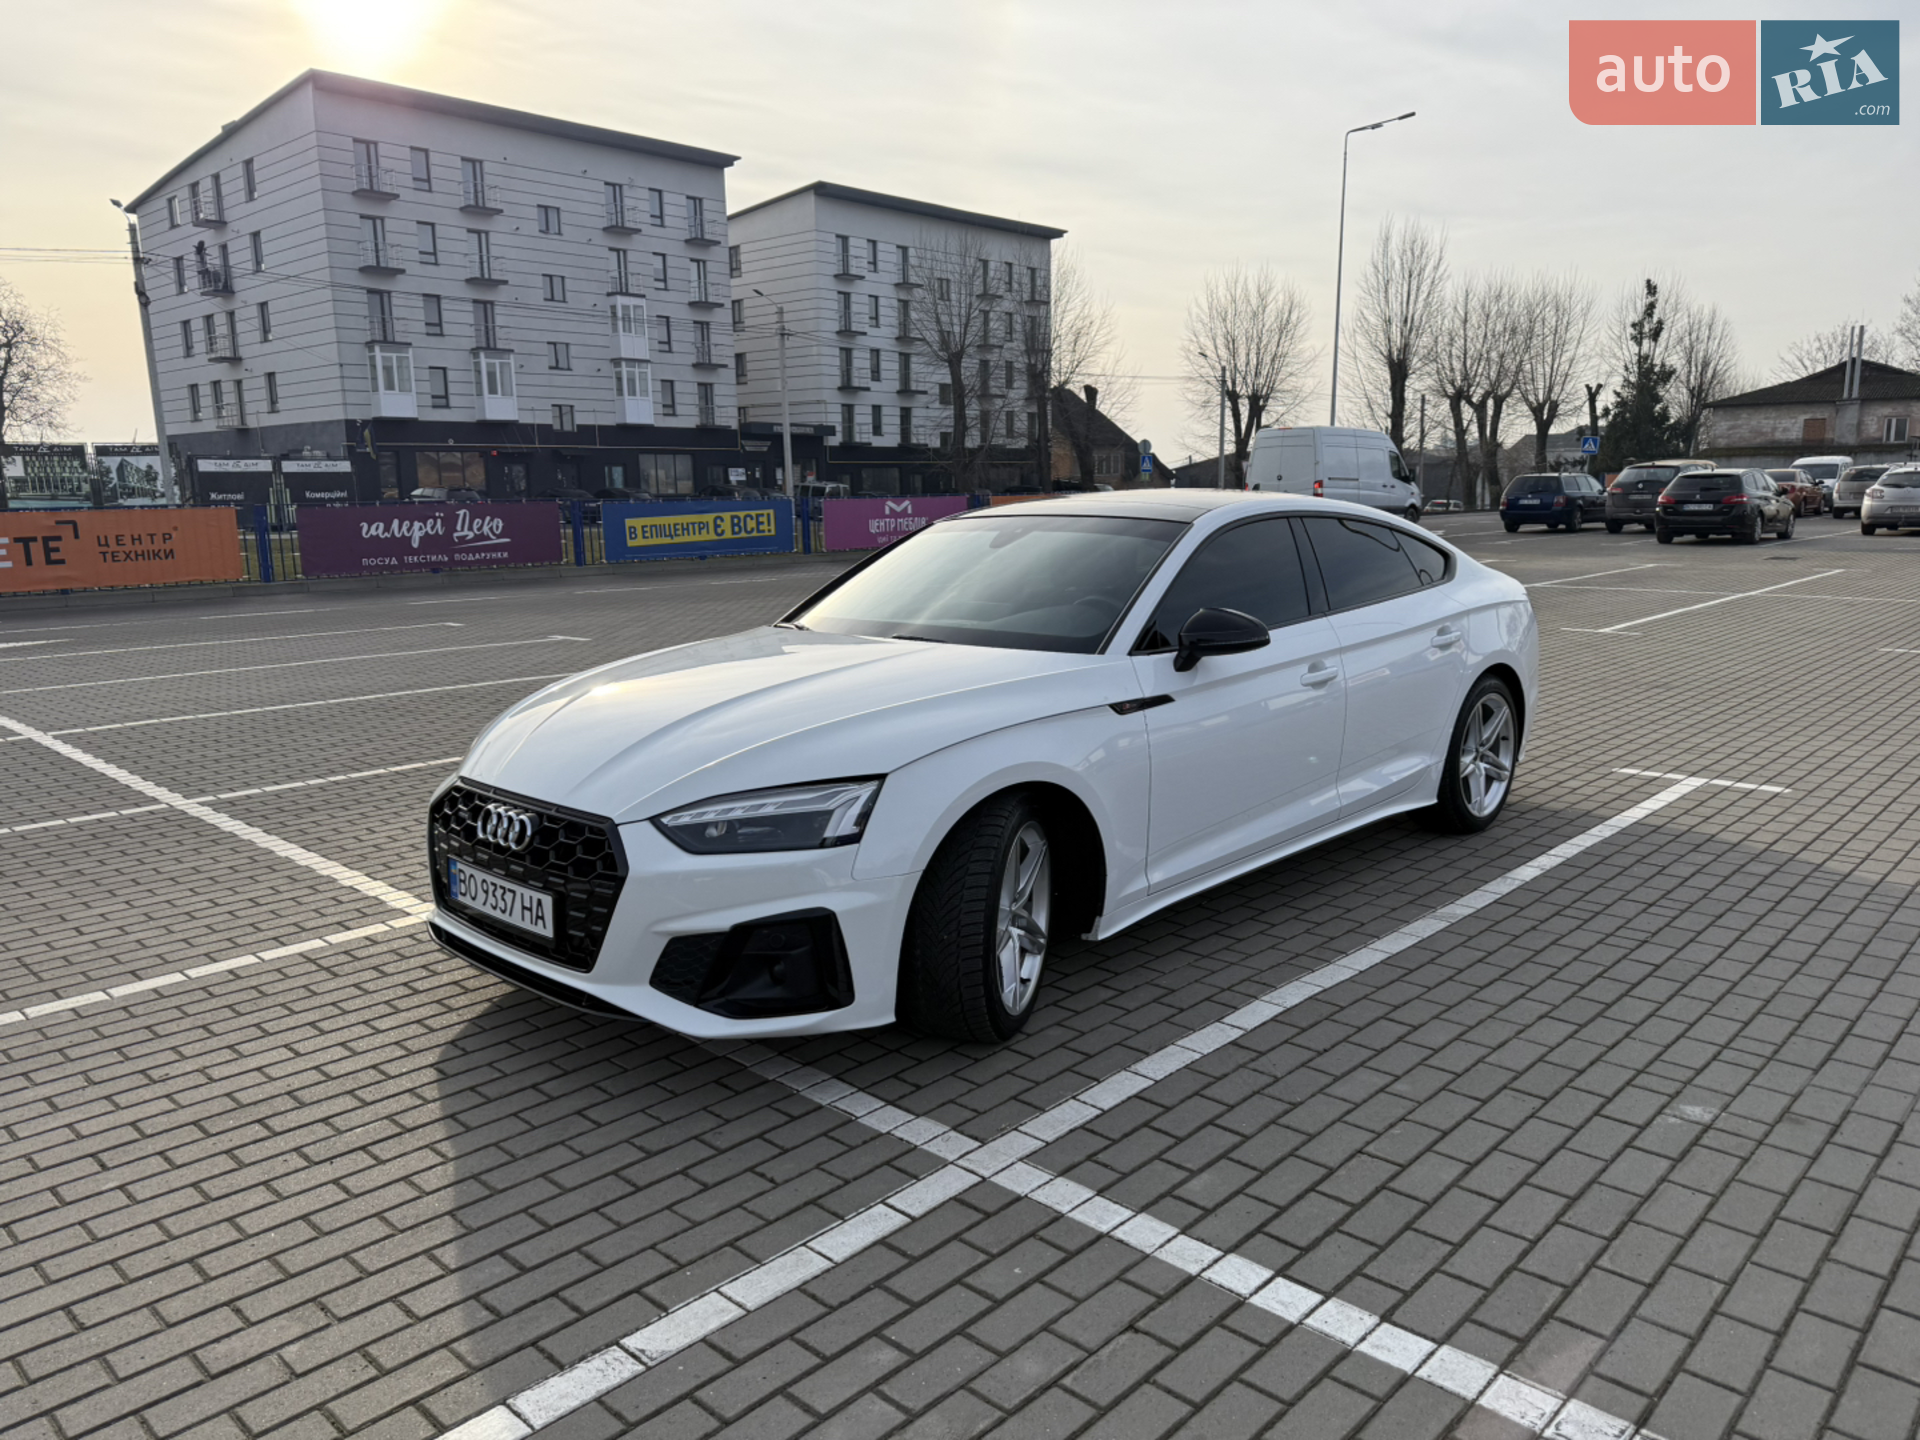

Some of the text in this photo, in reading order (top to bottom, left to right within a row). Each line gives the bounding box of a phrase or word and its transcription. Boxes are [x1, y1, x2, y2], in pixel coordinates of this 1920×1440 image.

[209, 491, 245, 500] Житлові
[359, 508, 505, 549] галереї Деко
[628, 512, 773, 541] В ЕПІЦЕНТРІ Є ВСЕ!
[868, 516, 927, 534] ЦЕНТР МЕБЛІВ
[97, 532, 174, 548] ЦЕНТР
[98, 548, 176, 564] ТЕХНІКИ
[362, 551, 509, 566] ПОСУД ТЕКСТИЛЬ ПОДАРУНКИ
[458, 867, 547, 930] BO 9337 HA
